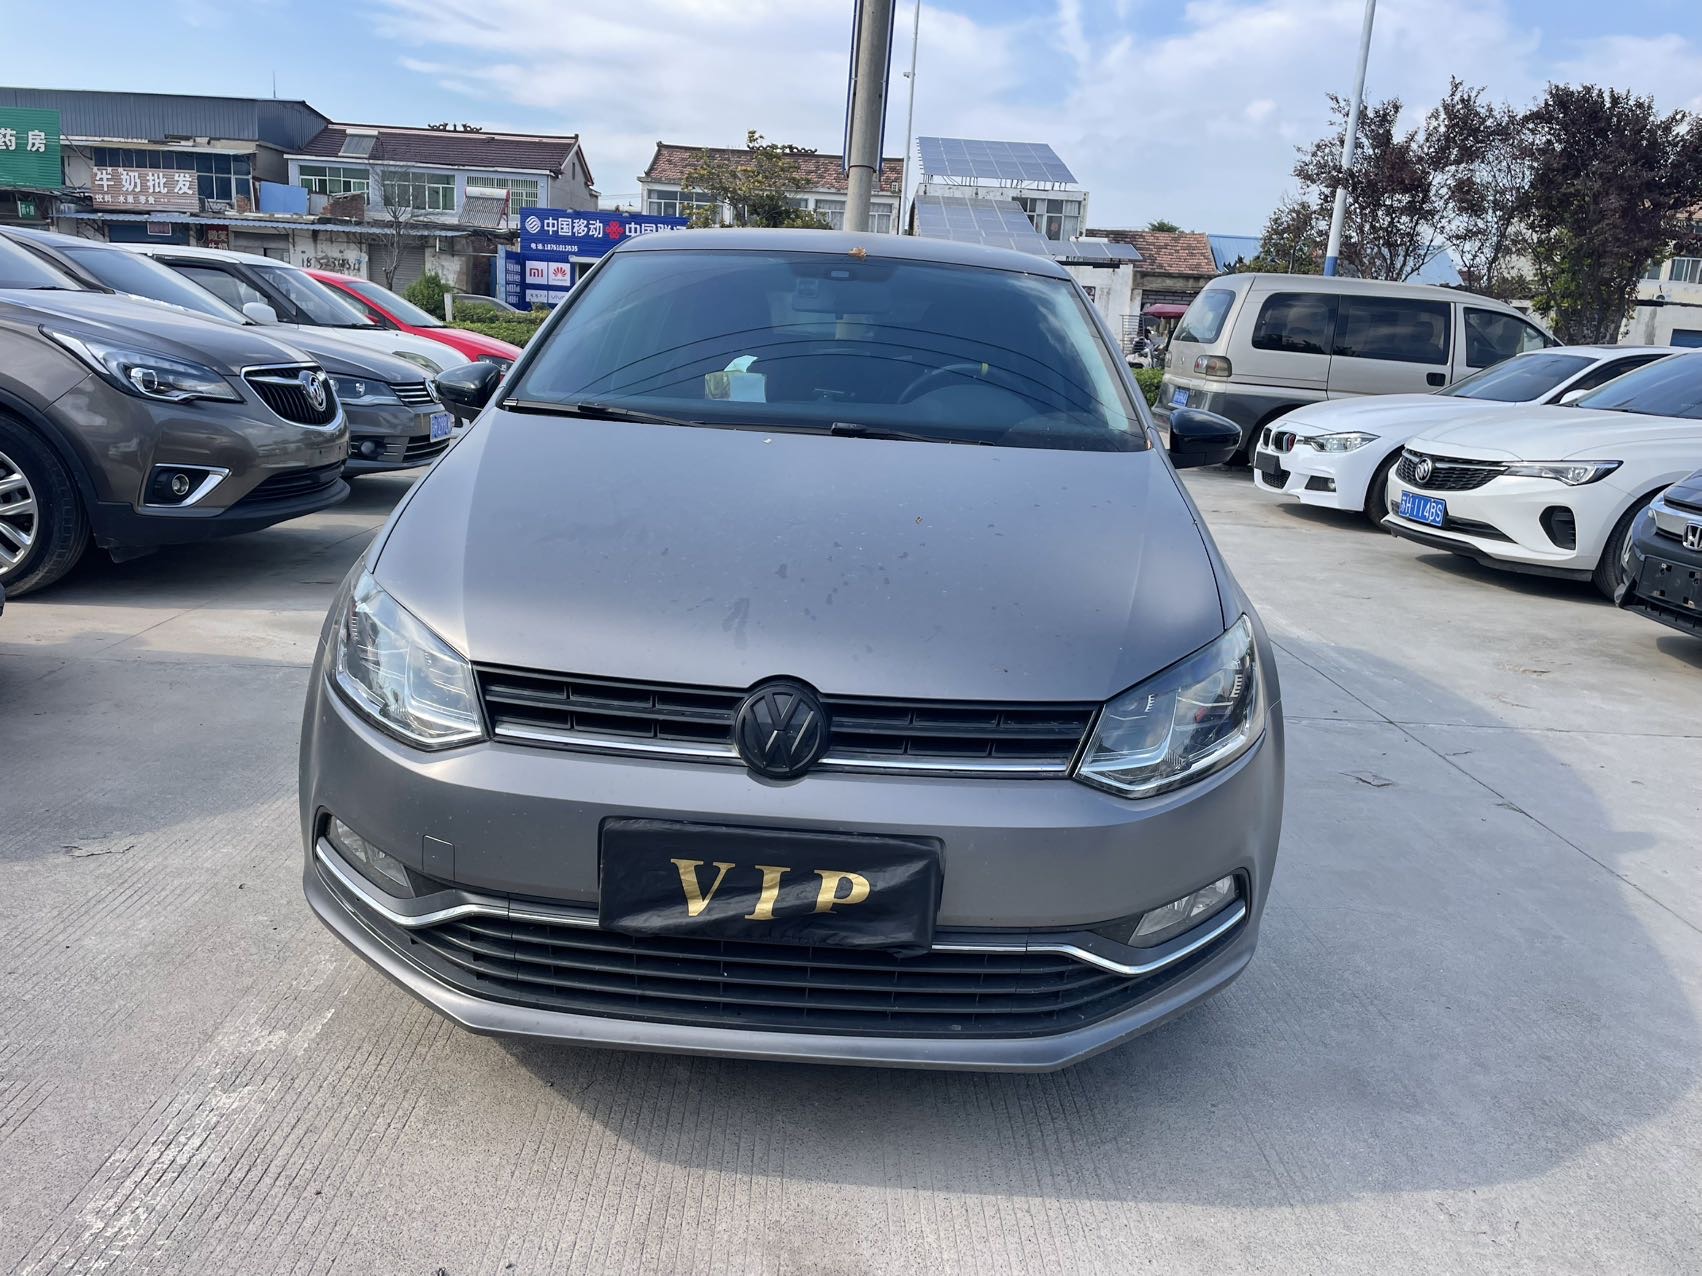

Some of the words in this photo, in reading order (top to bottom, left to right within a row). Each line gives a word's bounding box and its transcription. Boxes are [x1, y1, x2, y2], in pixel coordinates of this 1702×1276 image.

[0, 128, 46, 152] 药房
[95, 170, 193, 195] 牛奶批发
[544, 217, 603, 238] 中国移动
[670, 858, 871, 921] VIP
